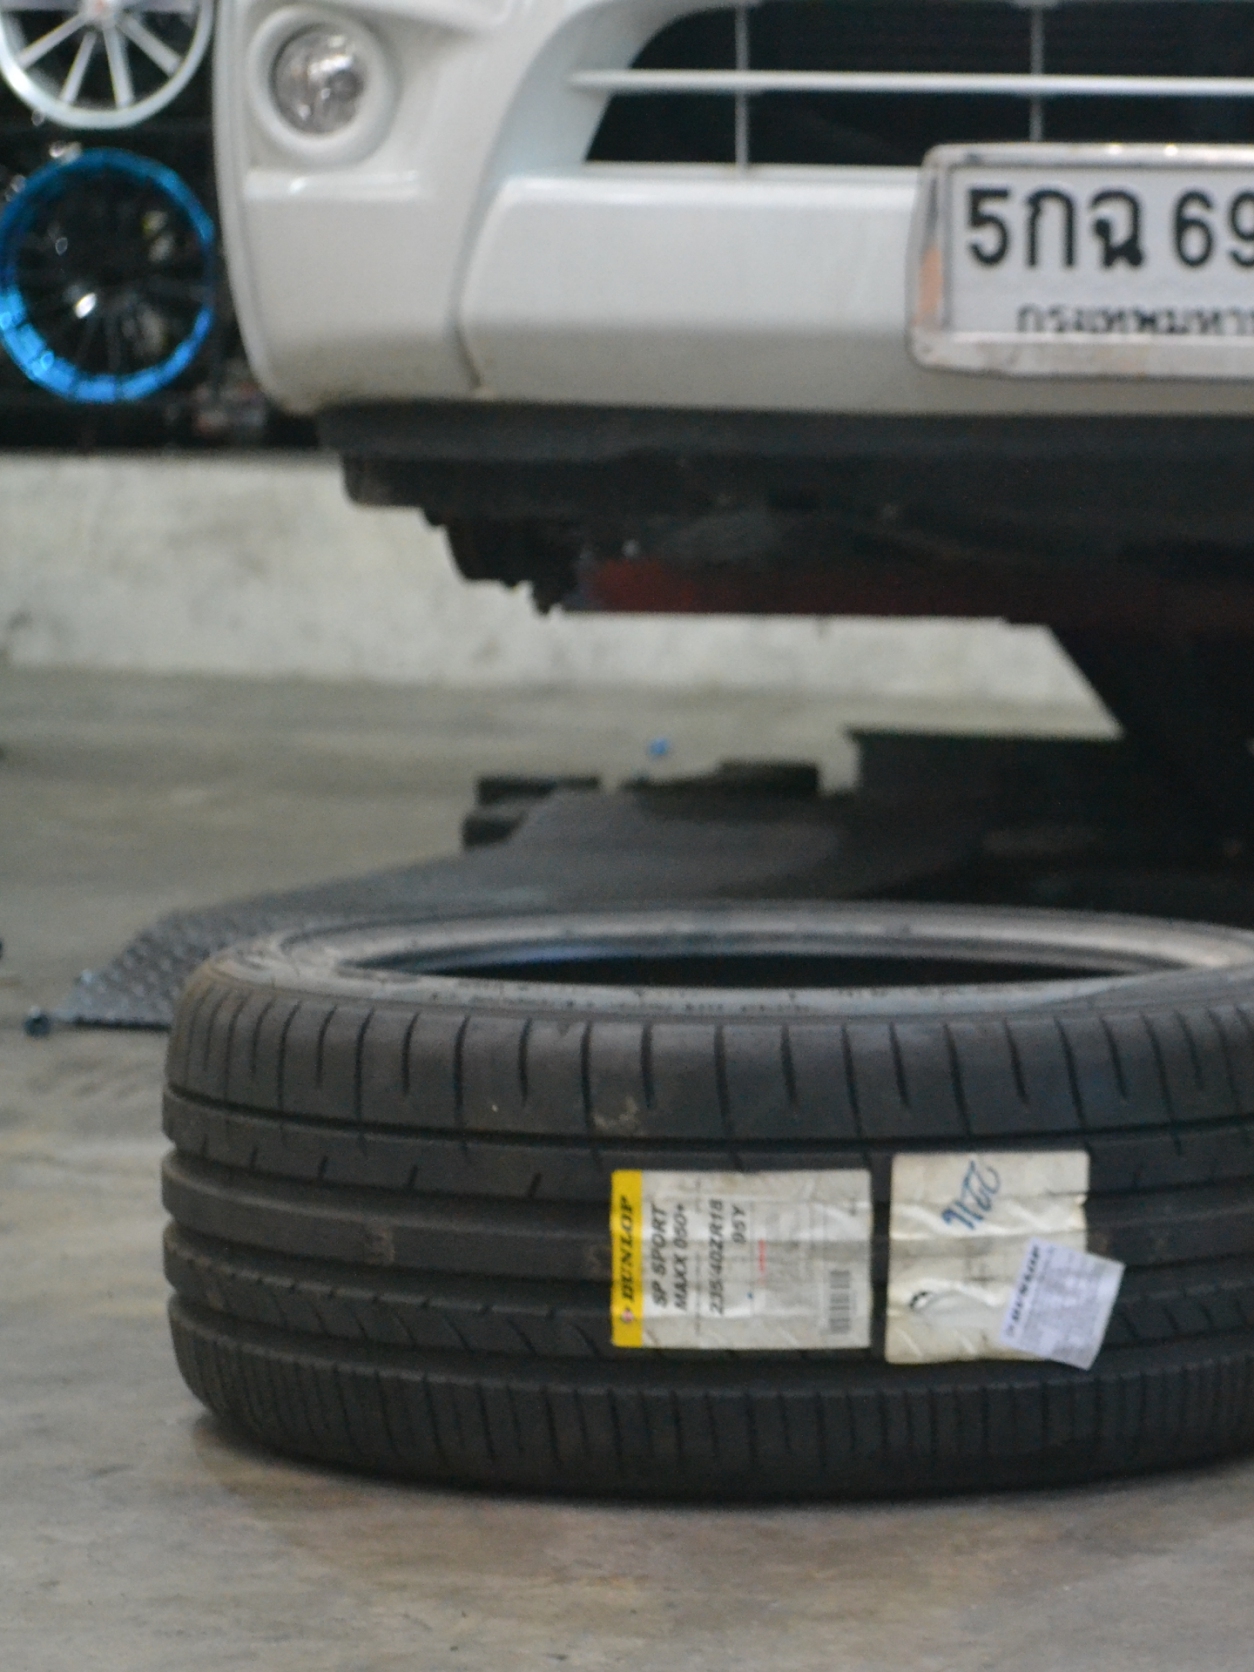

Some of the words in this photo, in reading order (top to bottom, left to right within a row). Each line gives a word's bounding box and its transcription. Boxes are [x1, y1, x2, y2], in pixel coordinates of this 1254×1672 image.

[968, 186, 1146, 270] 5กฉ
[620, 1195, 634, 1302] DUNLOP
[651, 1203, 667, 1276] SPORT
[732, 1204, 747, 1245] 95Y
[652, 1280, 668, 1308] SP
[674, 1254, 688, 1311] MAXX
